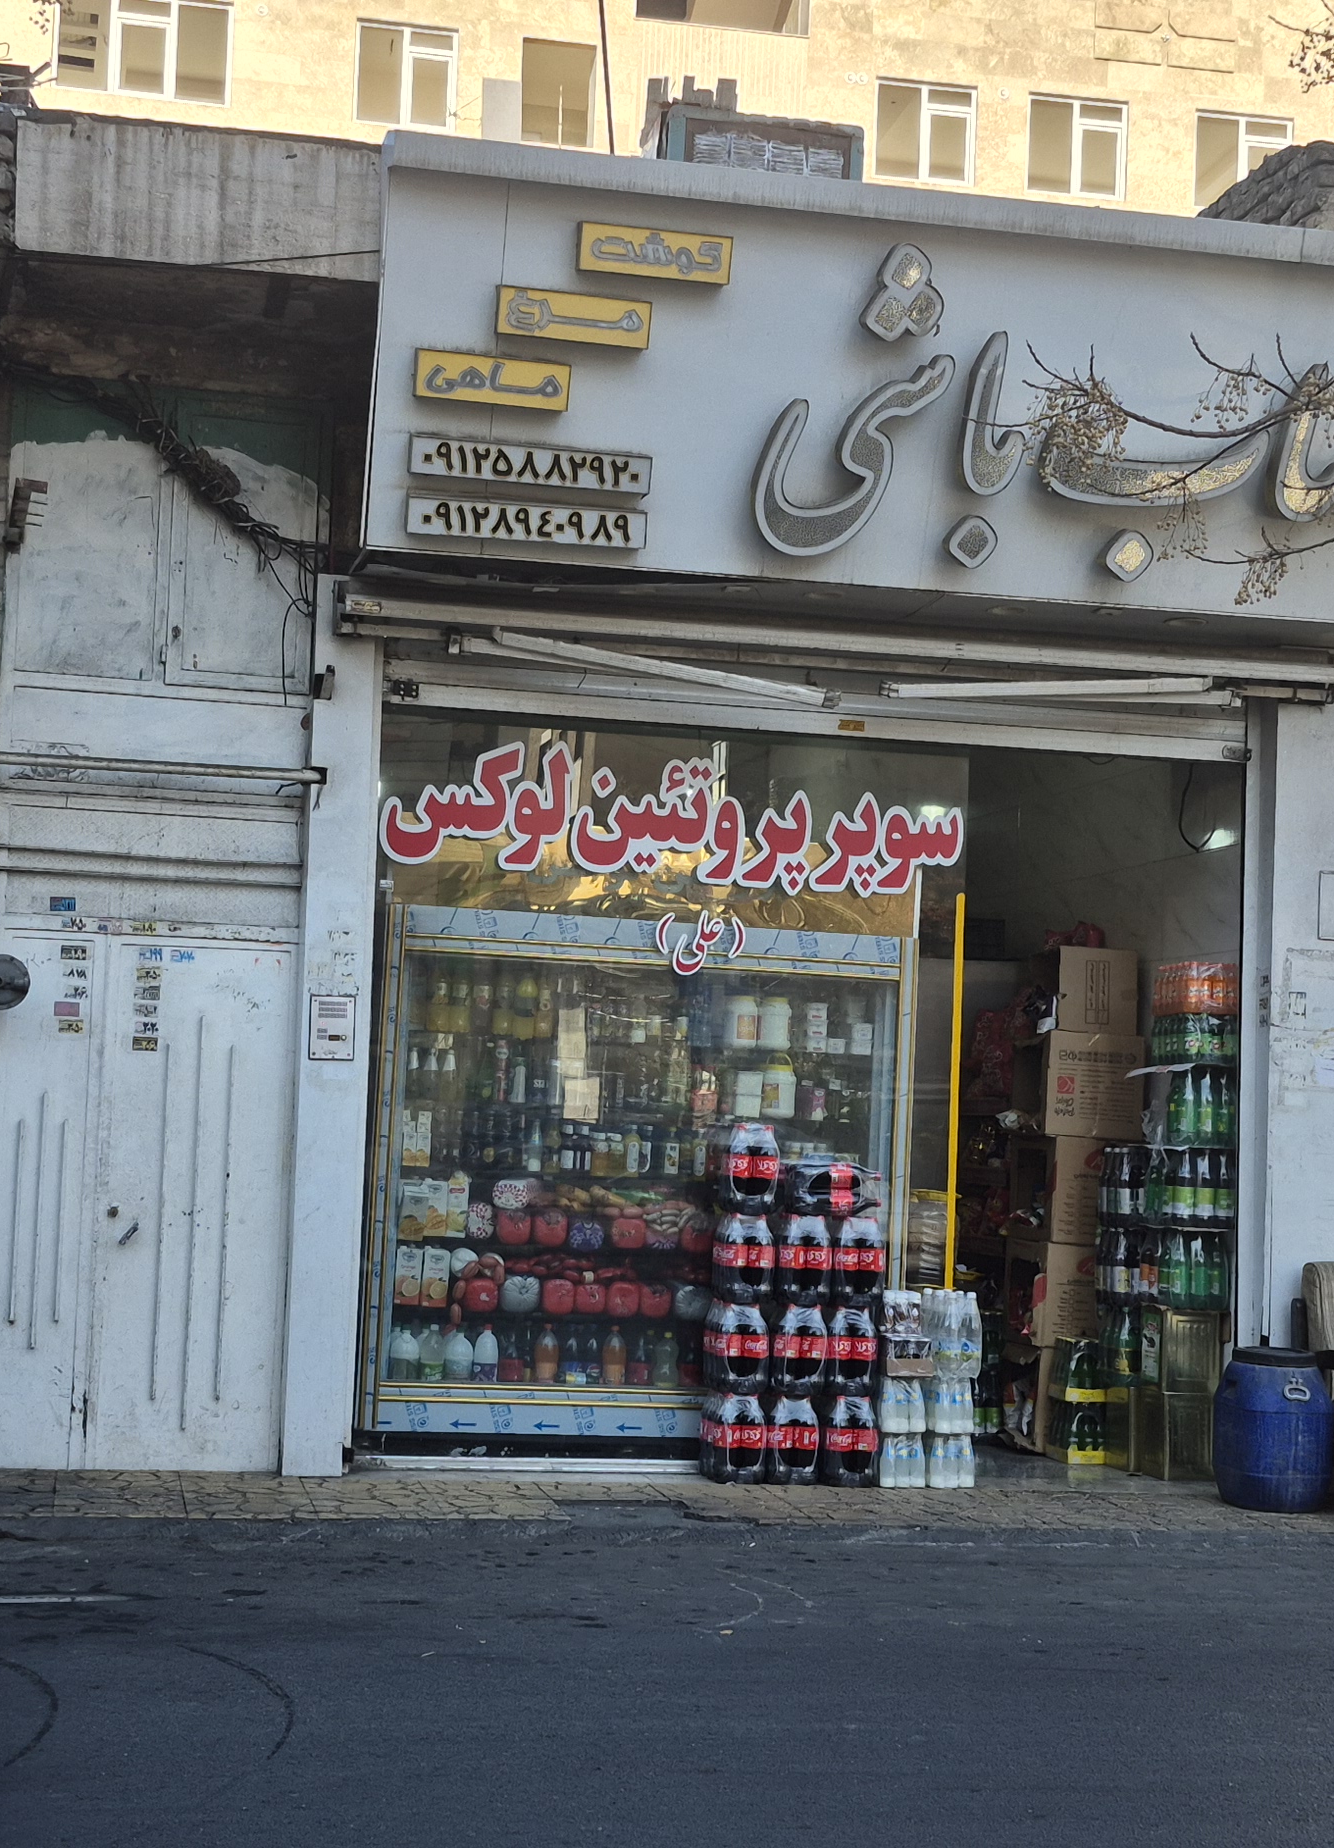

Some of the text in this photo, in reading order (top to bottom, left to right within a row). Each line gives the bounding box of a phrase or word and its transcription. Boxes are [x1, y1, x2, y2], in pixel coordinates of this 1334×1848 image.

[590, 232, 724, 276] گوشت
[506, 290, 644, 333] مرغ
[425, 362, 563, 398] ماهی
[752, 242, 1027, 568] باشی
[378, 740, 573, 873] لوکس
[809, 791, 964, 897] سوپر
